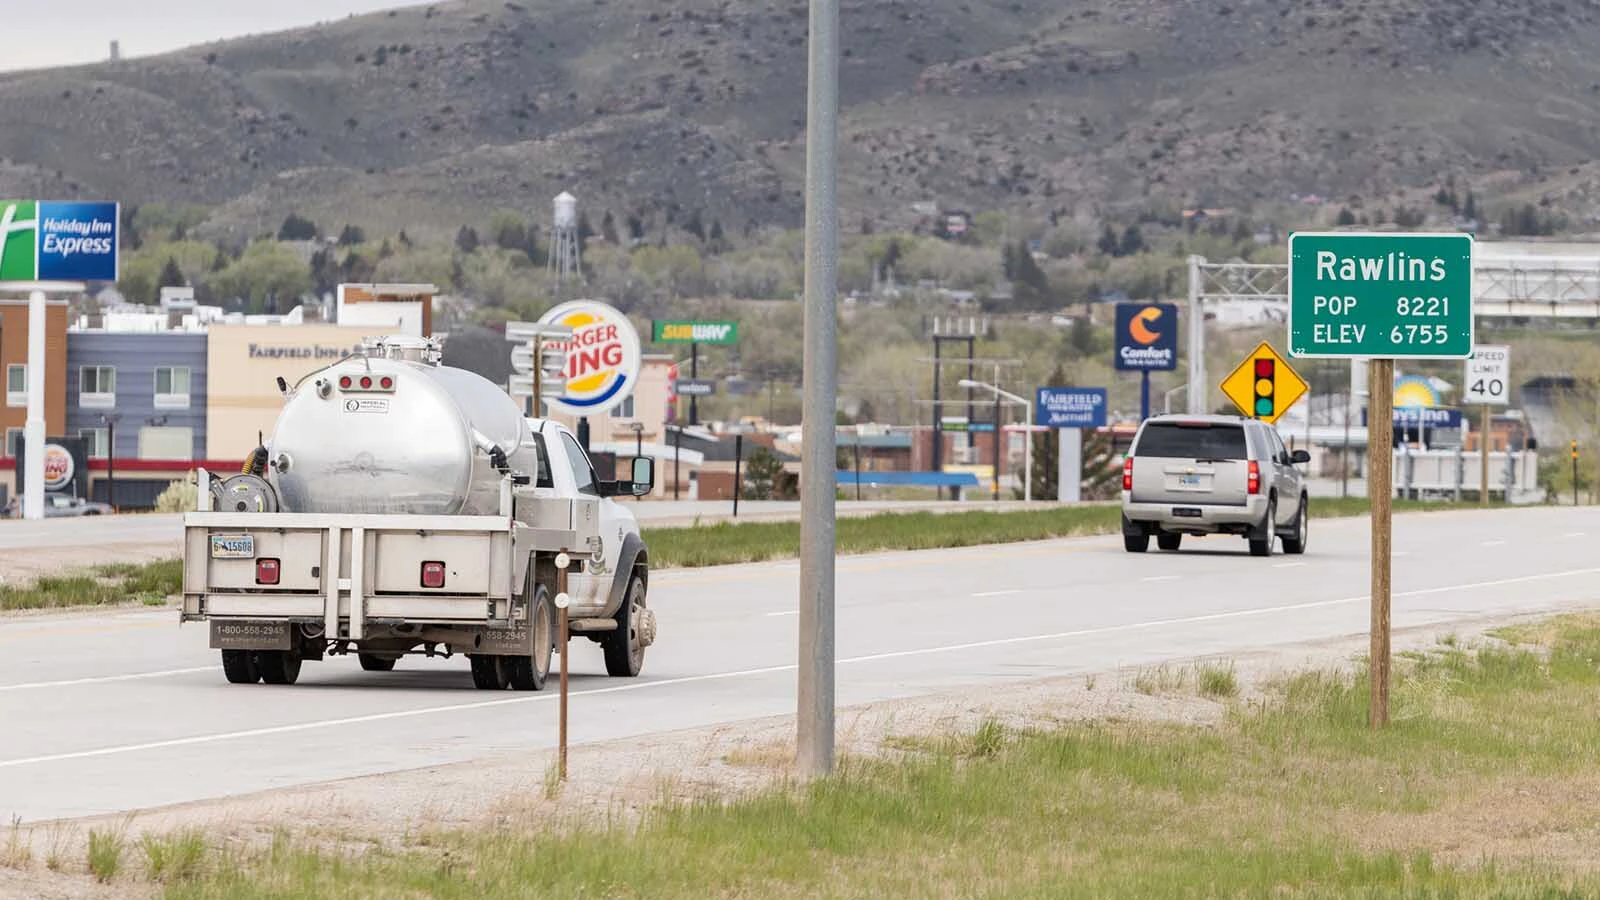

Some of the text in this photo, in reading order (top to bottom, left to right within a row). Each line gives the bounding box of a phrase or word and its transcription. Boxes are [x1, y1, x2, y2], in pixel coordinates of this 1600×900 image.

[43, 217, 112, 235] Holiday Inn
[43, 233, 112, 258] Express
[1317, 251, 1446, 281] Rawlins
[1313, 296, 1449, 316] POP 8221
[661, 324, 731, 339] SUBWAY
[1313, 324, 1448, 344] ELEV 6755
[248, 343, 311, 358] FAIRFIELD
[314, 344, 338, 358] INN
[1120, 346, 1171, 359] Comfort
[1475, 351, 1504, 360] PEED
[558, 343, 622, 378] ING
[1472, 365, 1501, 373] LIMIT
[1470, 378, 1503, 396] 40
[1041, 391, 1102, 404] FAIRFIELD
[1392, 409, 1417, 422] ays
[45, 464, 67, 472] ING
